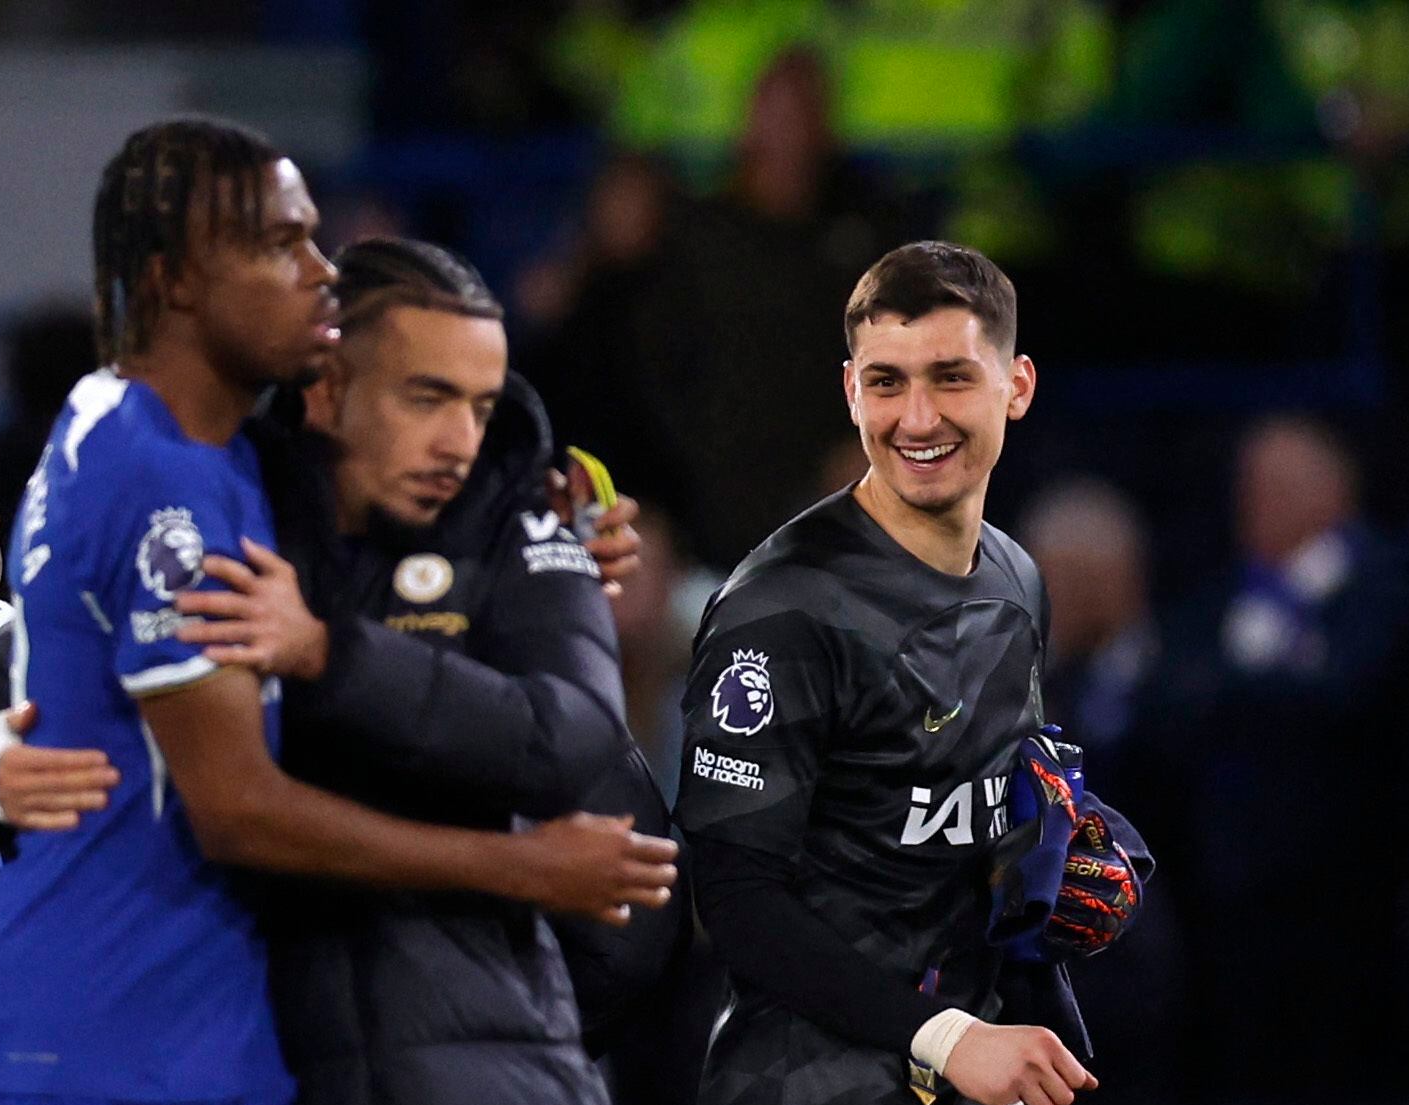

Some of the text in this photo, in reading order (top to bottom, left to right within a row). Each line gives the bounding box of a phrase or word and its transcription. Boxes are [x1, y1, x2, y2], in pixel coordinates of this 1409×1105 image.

[695, 746, 760, 777] No room
[713, 768, 765, 791] racism
[1065, 861, 1102, 878] sch
